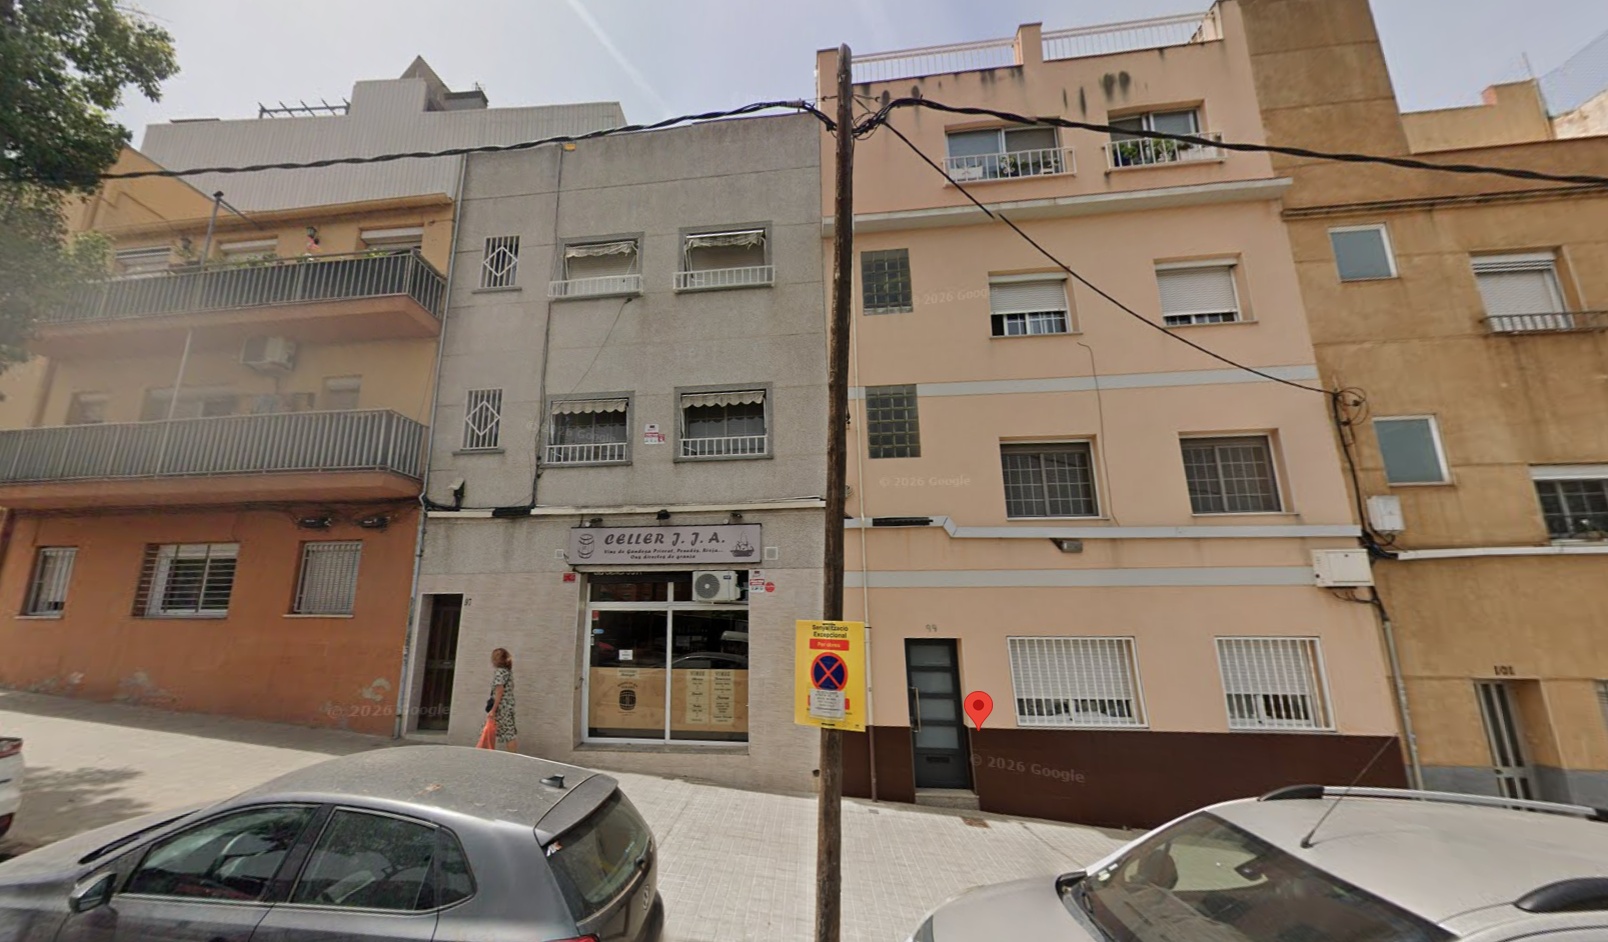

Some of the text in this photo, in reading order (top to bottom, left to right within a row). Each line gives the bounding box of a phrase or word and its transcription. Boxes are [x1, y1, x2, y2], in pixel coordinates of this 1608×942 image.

[604, 531, 725, 546] CELLER J. J. A.
[925, 624, 937, 633] 99
[813, 631, 848, 639] Excepcional
[1493, 665, 1516, 676] 101
